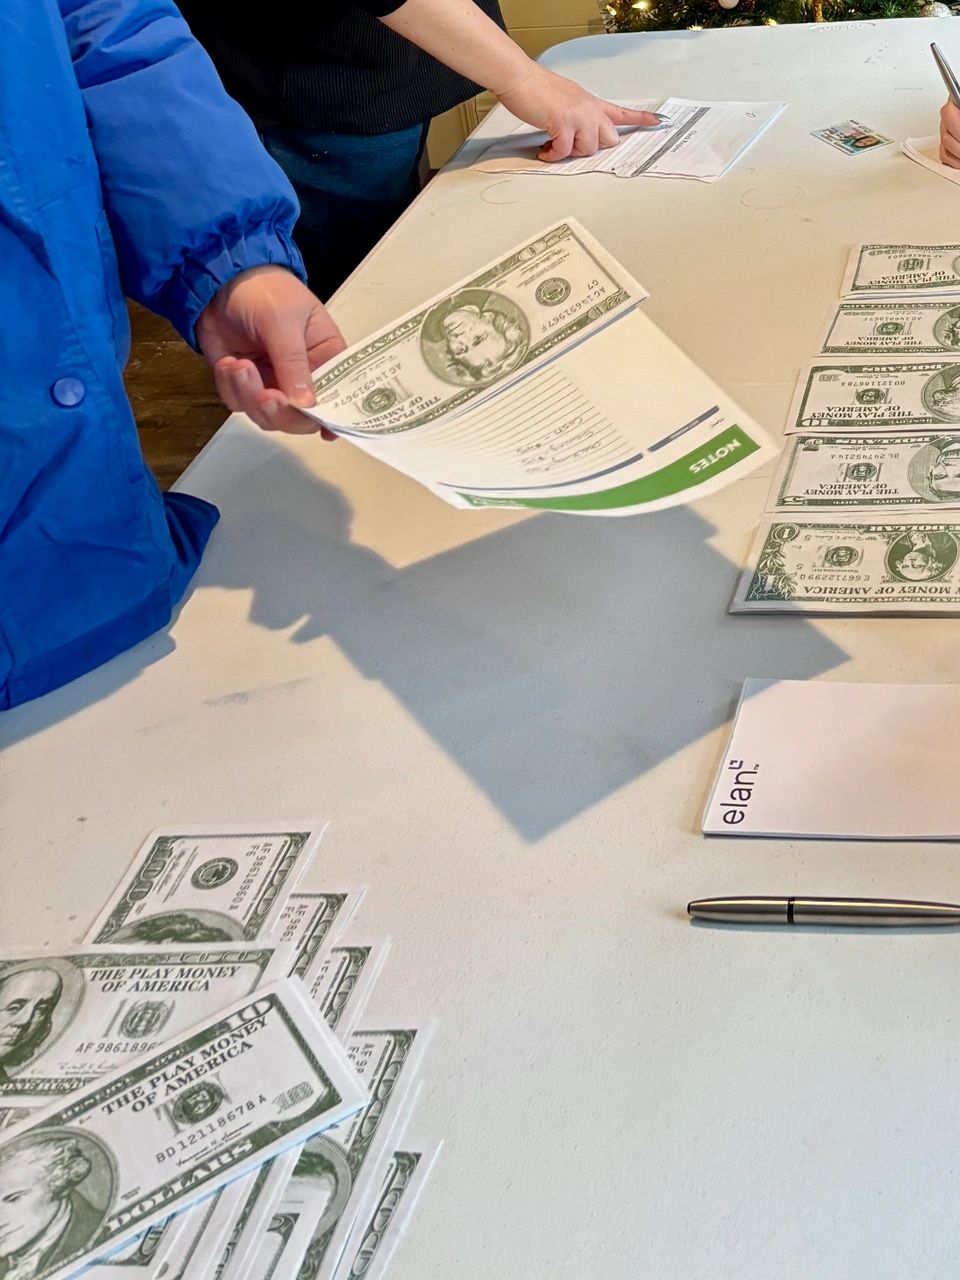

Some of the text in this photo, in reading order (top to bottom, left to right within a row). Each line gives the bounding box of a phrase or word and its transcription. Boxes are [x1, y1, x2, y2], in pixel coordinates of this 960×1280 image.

[881, 272, 929, 280] AMERICA
[908, 276, 932, 284] PLAY
[416, 396, 441, 411] THE
[689, 439, 741, 473] NOTES
[868, 525, 946, 533] DOLLAR
[898, 586, 952, 594] MONEY
[720, 770, 758, 825] elan
[89, 966, 242, 982] THE PLAY MONEY
[101, 980, 211, 993] OF AMERICA
[75, 1043, 95, 1054] AF
[101, 1015, 269, 1115] THE PLAY MONEY
[132, 1042, 254, 1113] OF AMERICA
[109, 1139, 254, 1230] DOLLARS
